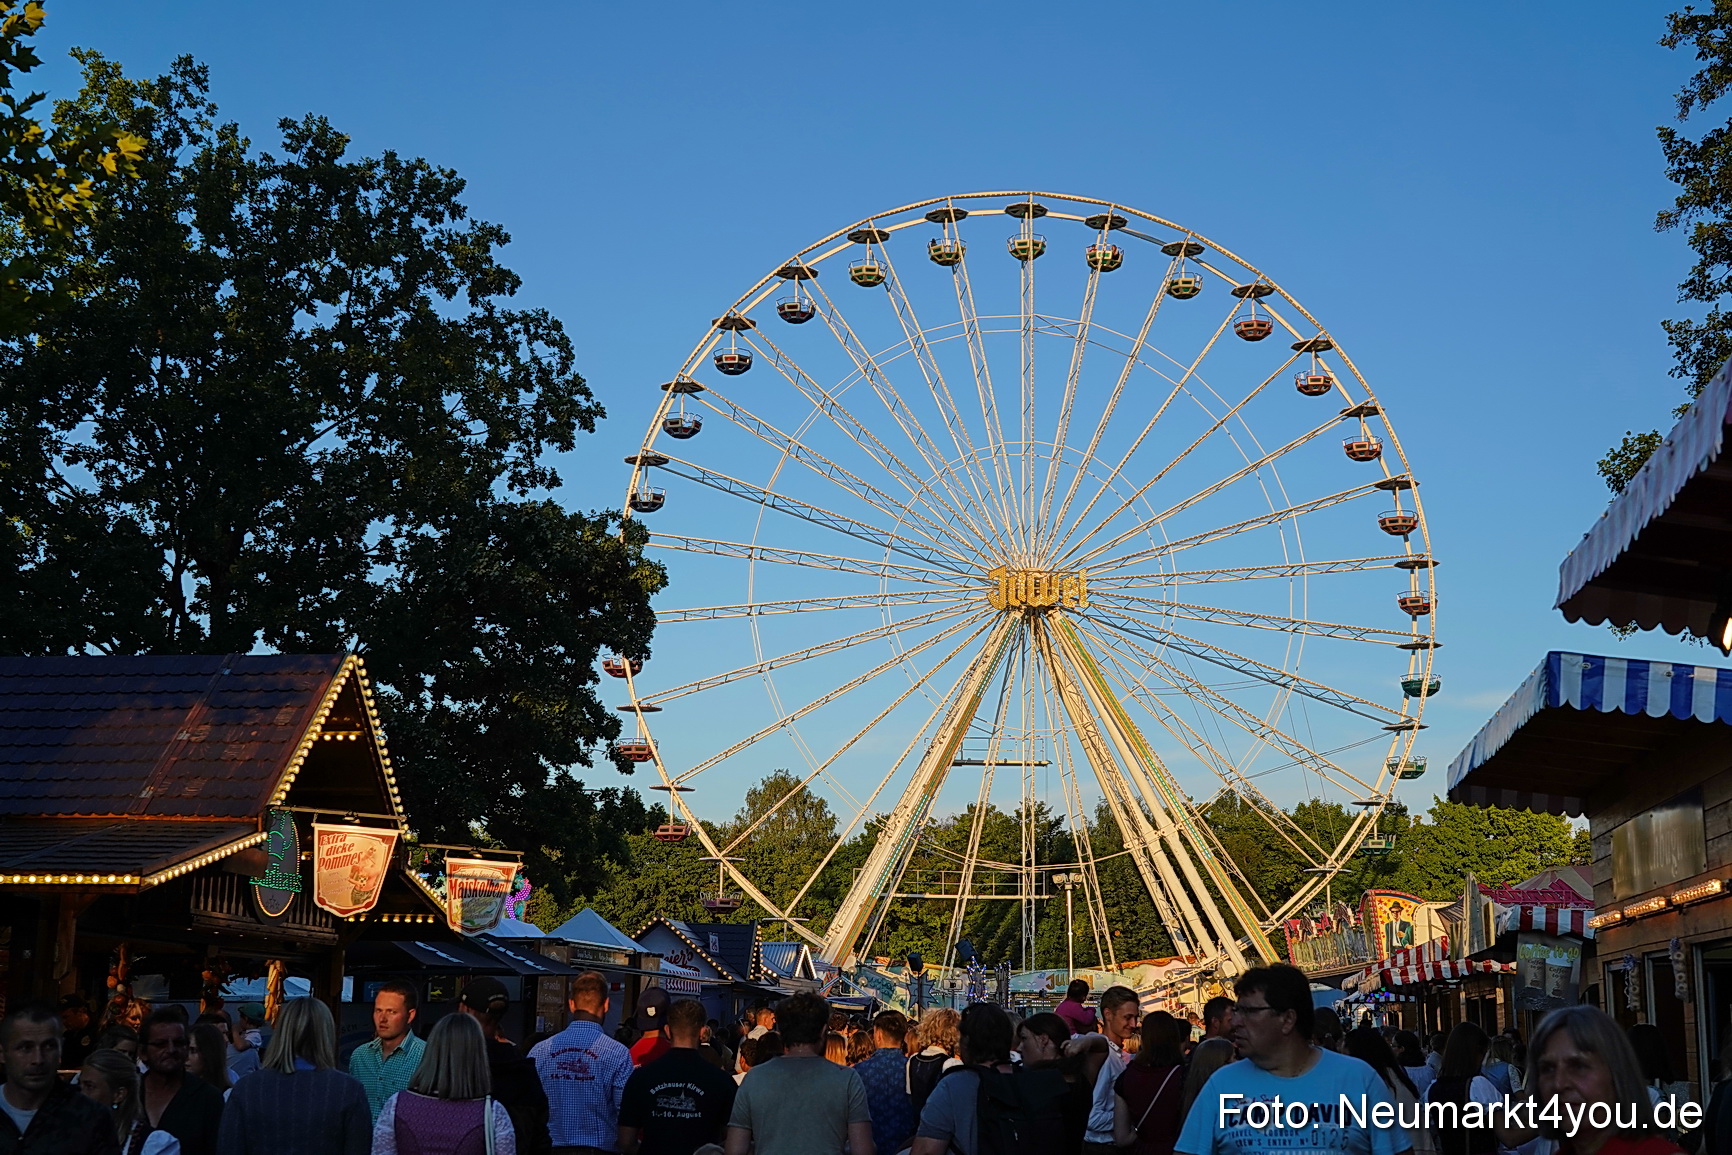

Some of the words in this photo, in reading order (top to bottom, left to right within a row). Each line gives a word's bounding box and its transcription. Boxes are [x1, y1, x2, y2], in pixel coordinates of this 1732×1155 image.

[320, 834, 347, 846] Extra
[326, 843, 355, 857] dicke
[317, 852, 363, 873] Pommes
[449, 878, 504, 899] Maiskolben
[1520, 943, 1550, 960] Coffee
[1553, 944, 1564, 959] to
[1566, 946, 1580, 963] go
[676, 1111, 702, 1119] August
[1267, 1138, 1292, 1146] ENTRY
